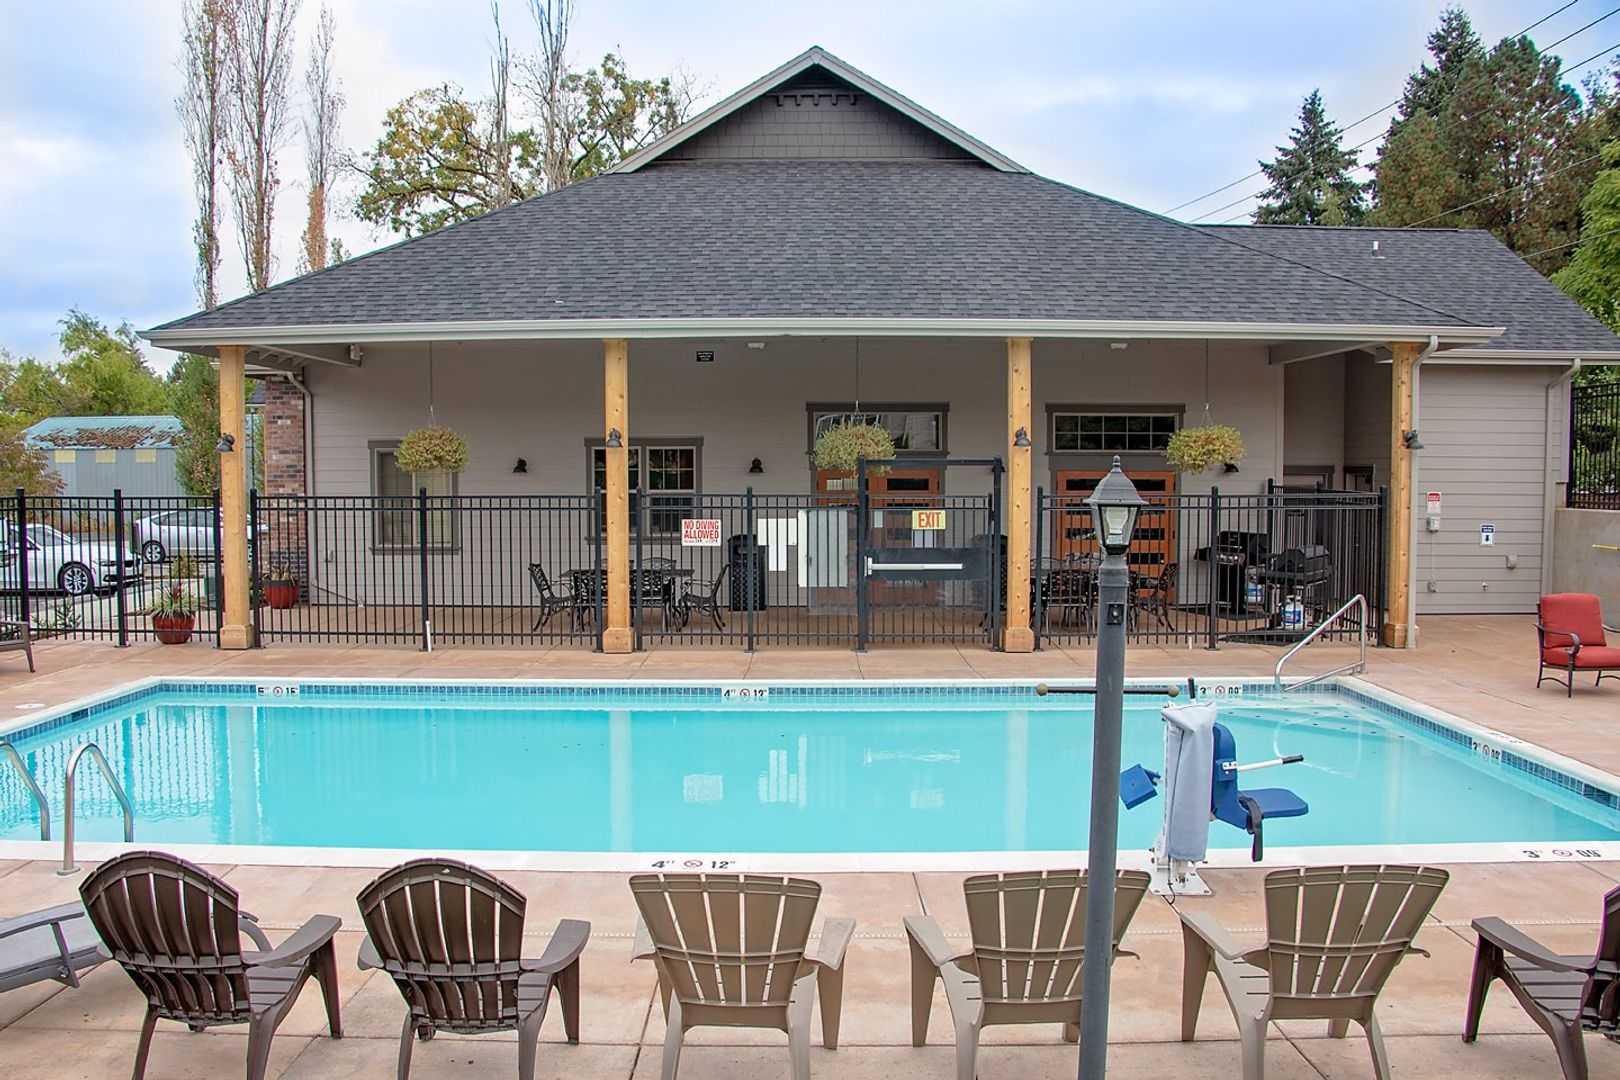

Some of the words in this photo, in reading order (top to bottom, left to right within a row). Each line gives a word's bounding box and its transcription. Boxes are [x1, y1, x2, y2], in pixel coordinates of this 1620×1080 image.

[918, 511, 942, 528] EXIT
[684, 520, 694, 530] NO
[695, 520, 719, 530] DIVING
[684, 529, 719, 539] ALLOWED
